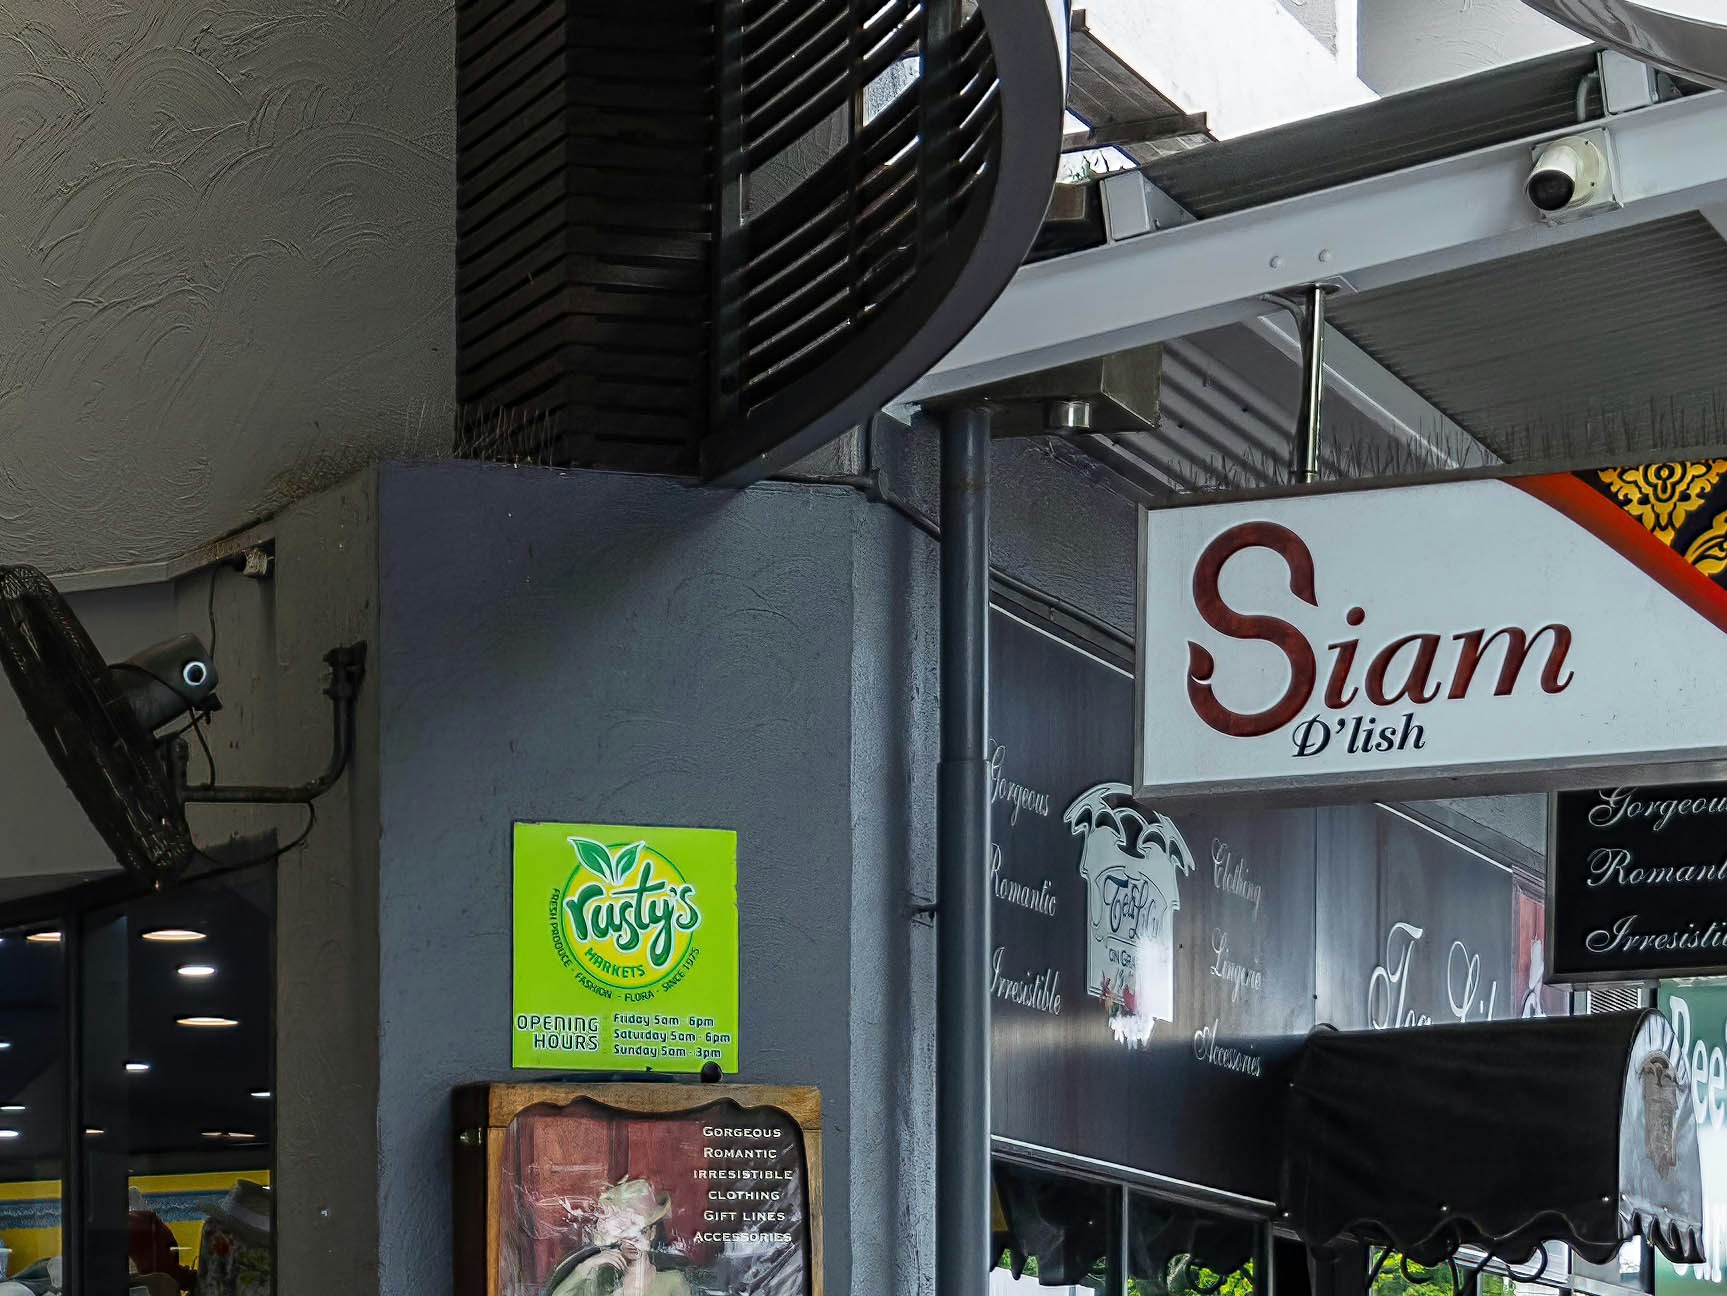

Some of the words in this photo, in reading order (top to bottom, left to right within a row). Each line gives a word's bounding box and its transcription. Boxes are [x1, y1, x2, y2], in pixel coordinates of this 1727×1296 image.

[1187, 520, 1575, 738] Siam
[1291, 711, 1426, 758] D'lish
[990, 738, 1051, 826] Gorgeous
[990, 843, 1057, 917] Romantic
[1211, 838, 1264, 913] Clothing
[566, 861, 699, 967] rusty's
[584, 948, 646, 978] MARKETS
[990, 947, 1063, 1017] Irresistible
[1210, 928, 1263, 1002] Lingerie
[662, 972, 686, 993] SINCE
[517, 1015, 599, 1032] OPENING
[614, 1013, 650, 1027] Friday
[654, 1014, 679, 1026] 5am
[689, 1016, 715, 1028] 6pm
[614, 1029, 667, 1043] Saturday
[671, 1031, 696, 1042] 5am
[705, 1032, 731, 1044] 6pm
[534, 1034, 599, 1050] HOURS
[614, 1045, 657, 1058] Sunday
[661, 1046, 686, 1057] 5am
[696, 1048, 722, 1060] 3pm
[1194, 1019, 1264, 1078] Accessories
[708, 1191, 780, 1201] CLOTHING
[743, 1211, 786, 1222] LINES
